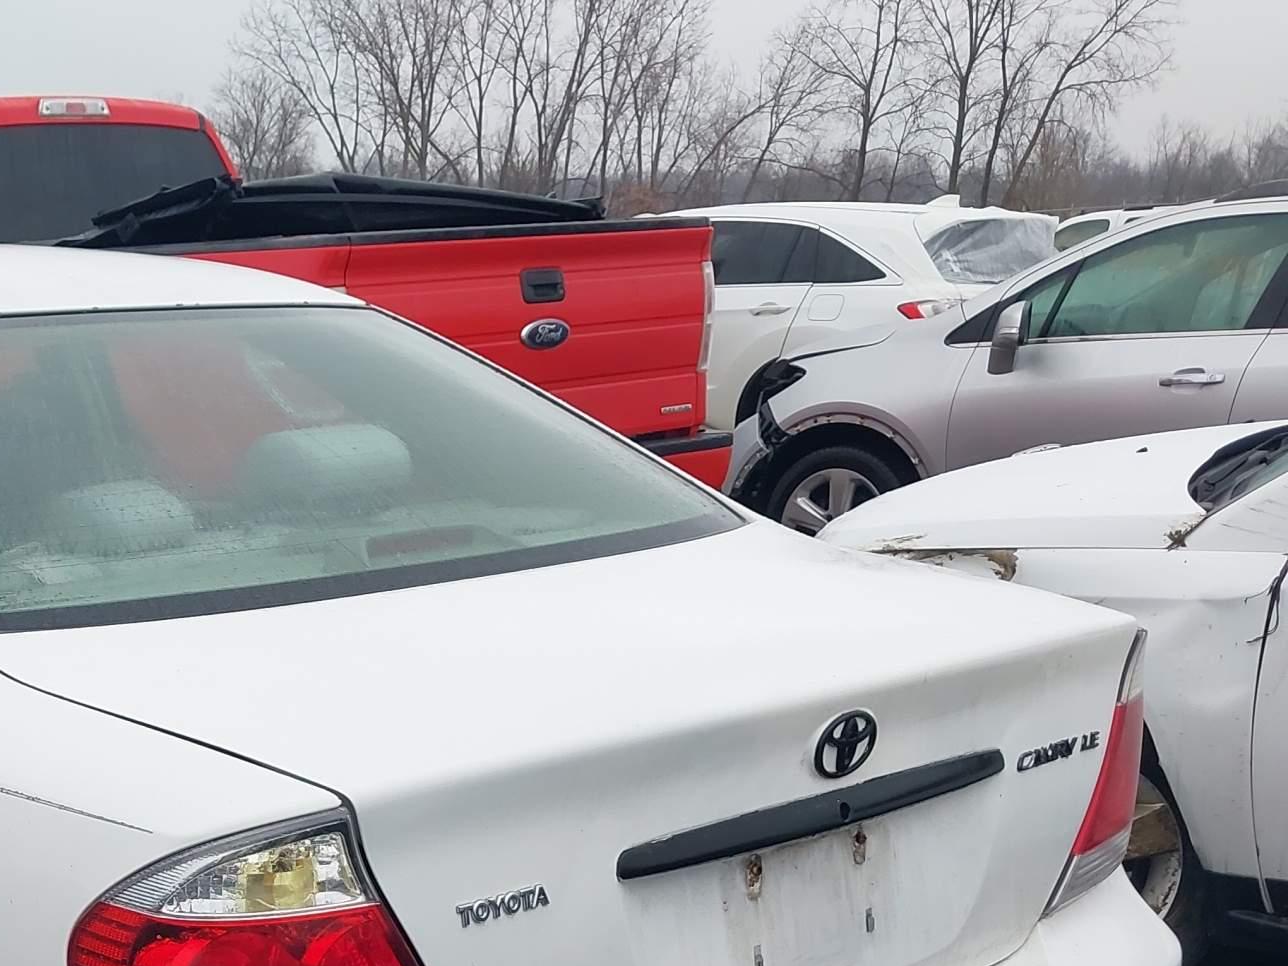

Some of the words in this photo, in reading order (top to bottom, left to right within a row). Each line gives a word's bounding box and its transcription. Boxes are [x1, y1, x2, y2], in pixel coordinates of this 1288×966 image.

[536, 324, 563, 343] Ford
[1080, 731, 1100, 752] LE
[456, 884, 550, 928] TOYOTA
